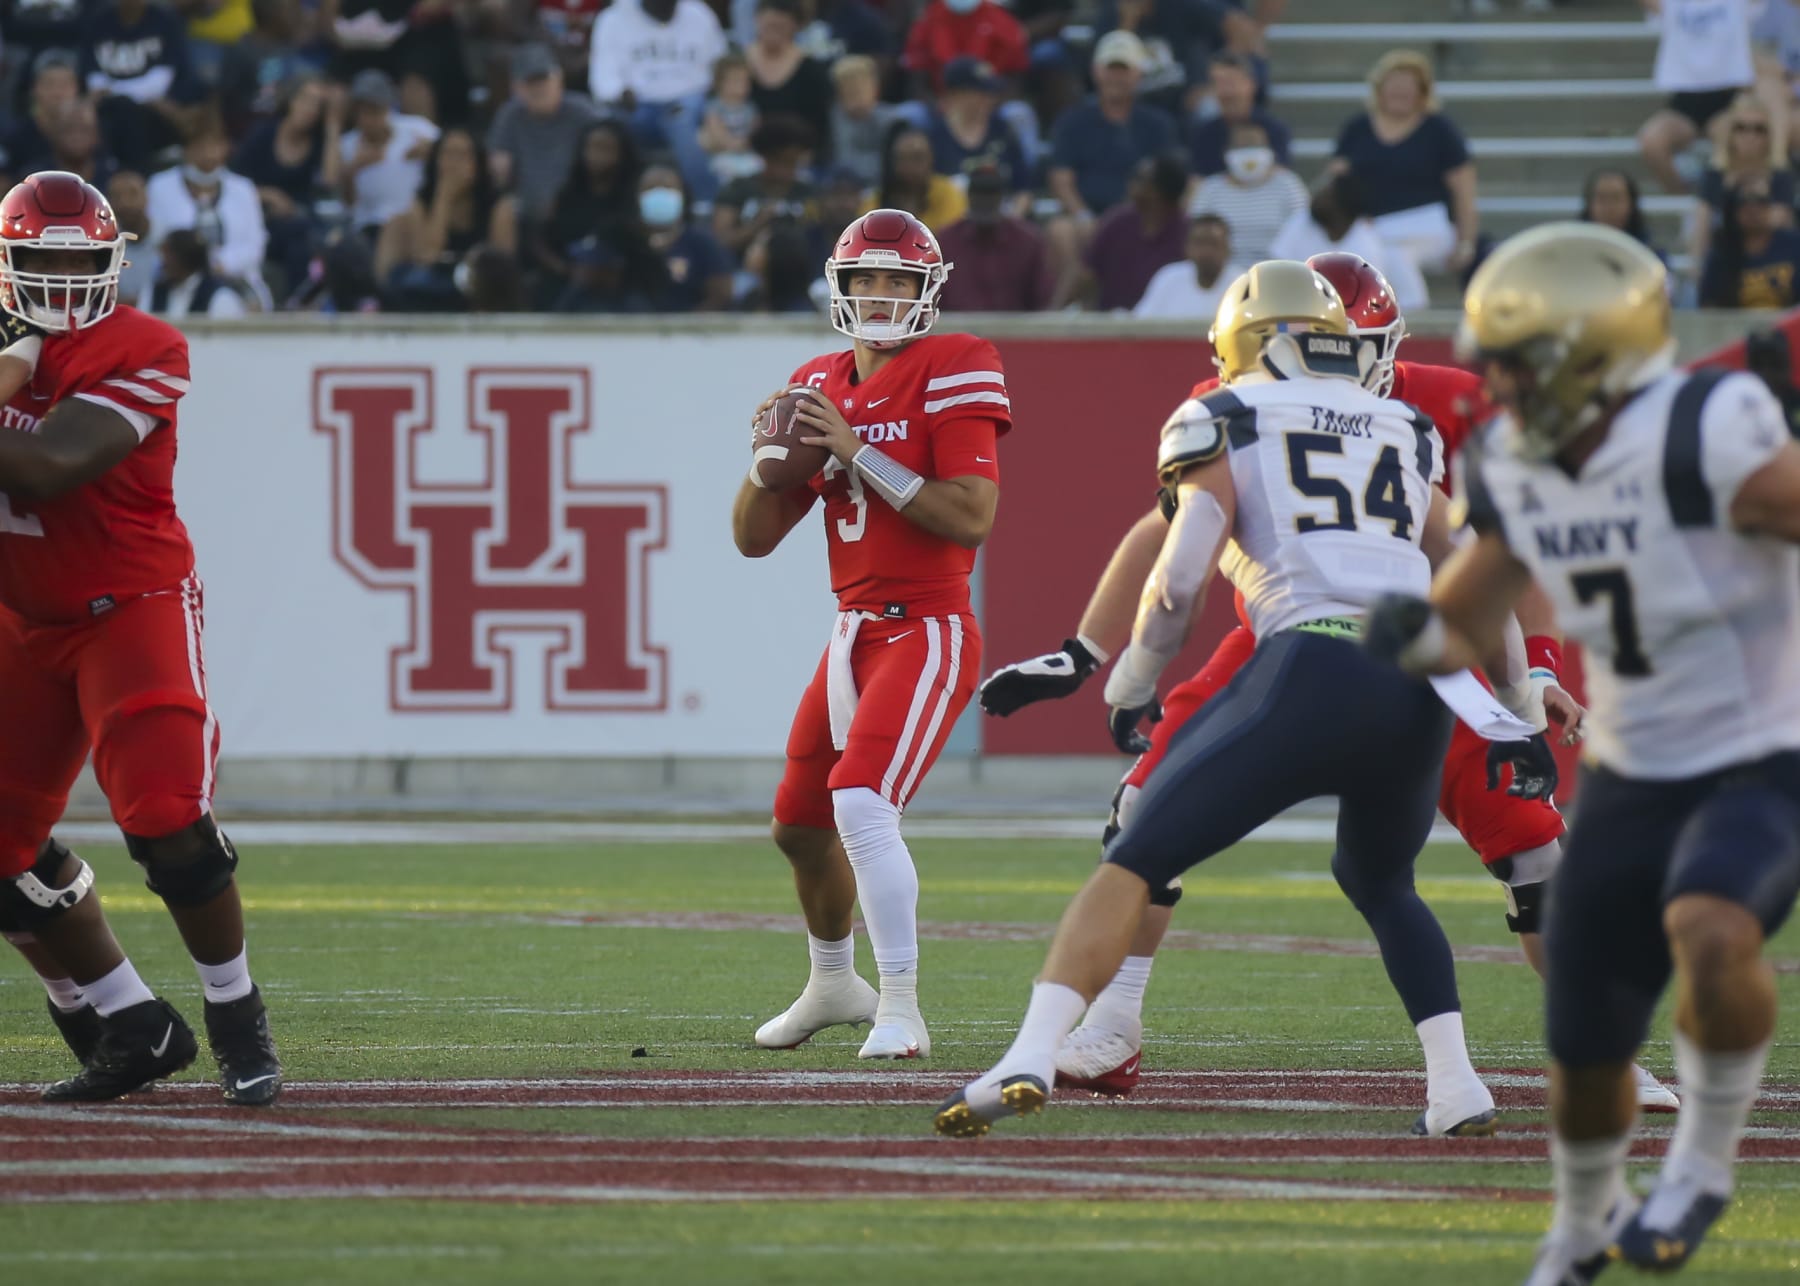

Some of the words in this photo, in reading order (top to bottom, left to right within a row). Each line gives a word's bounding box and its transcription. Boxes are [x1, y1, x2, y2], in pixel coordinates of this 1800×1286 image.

[850, 419, 909, 444] TON
[823, 455, 868, 543] 3
[1282, 430, 1416, 542] 54
[313, 365, 669, 713] UH
[1534, 516, 1639, 560] NAVY
[889, 606, 900, 615] M
[1569, 566, 1655, 678] 7
